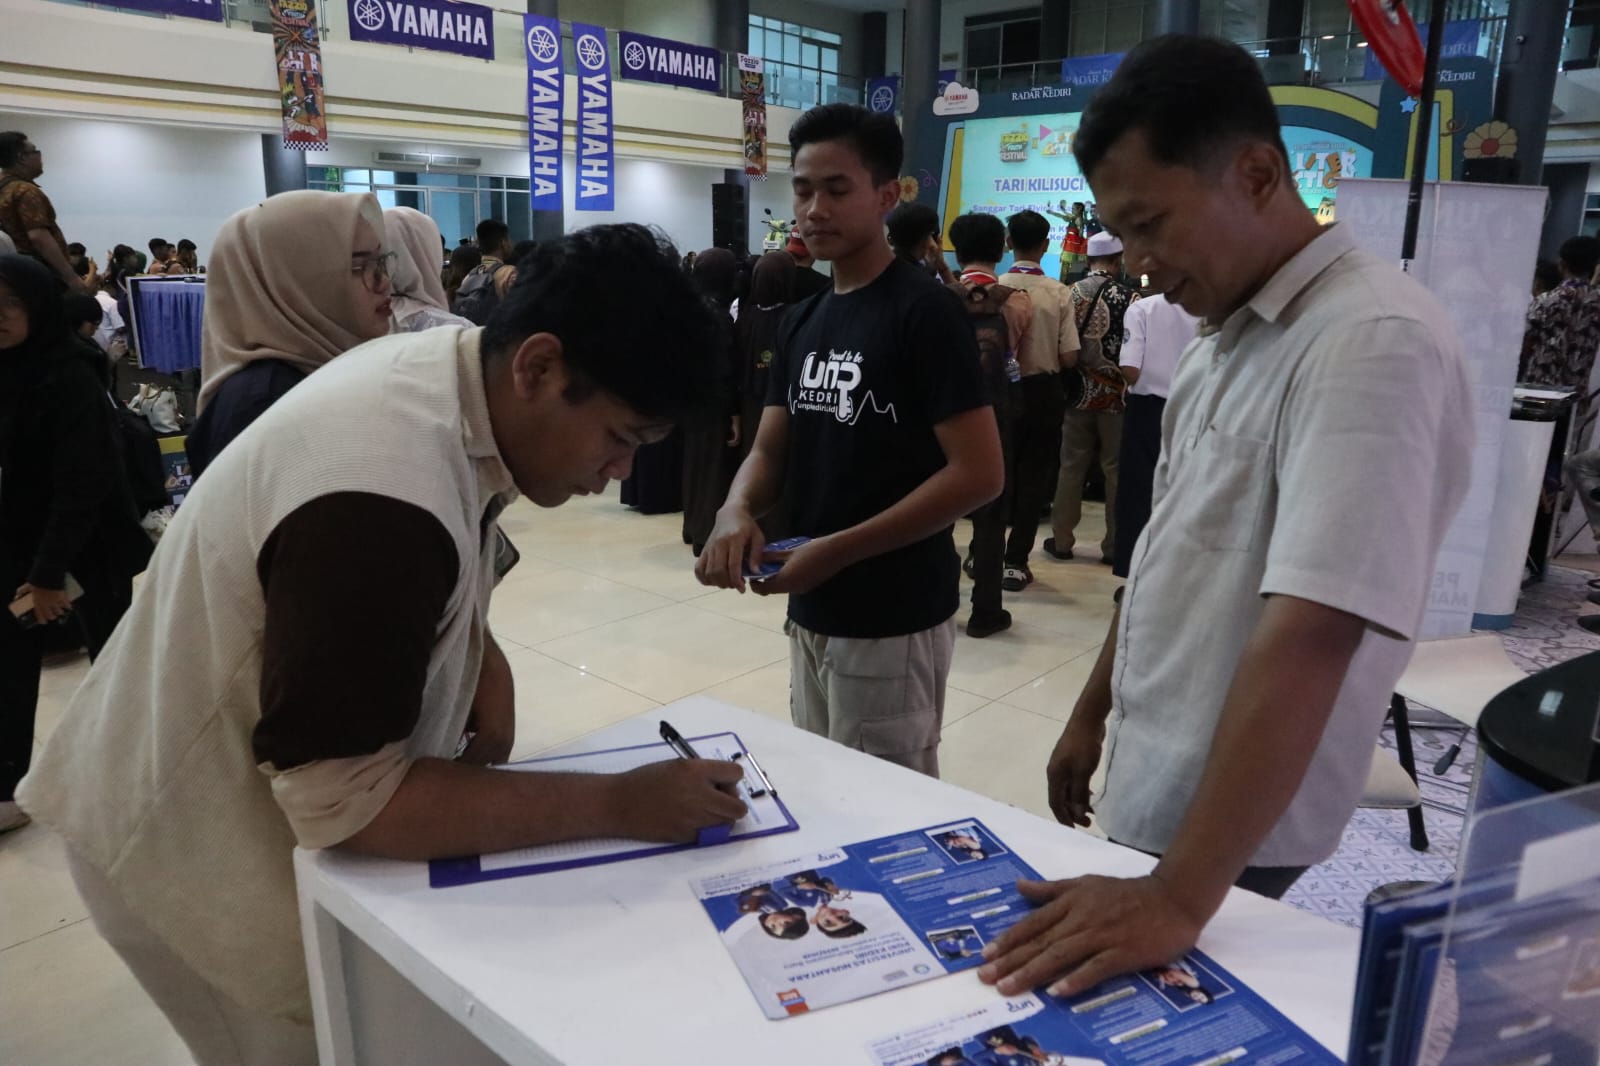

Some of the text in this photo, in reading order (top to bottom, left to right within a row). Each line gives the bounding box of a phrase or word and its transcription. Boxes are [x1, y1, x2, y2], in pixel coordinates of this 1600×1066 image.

[386, 1, 488, 46] YAMAHA
[646, 46, 716, 81] YAMAHA
[1012, 87, 1072, 101] RADAR KEDIRI
[533, 67, 559, 197] YAMAHA
[581, 74, 608, 198] YAMAHA
[994, 177, 1084, 192] TARI KILISUCI
[973, 205, 1007, 214] Sanggar
